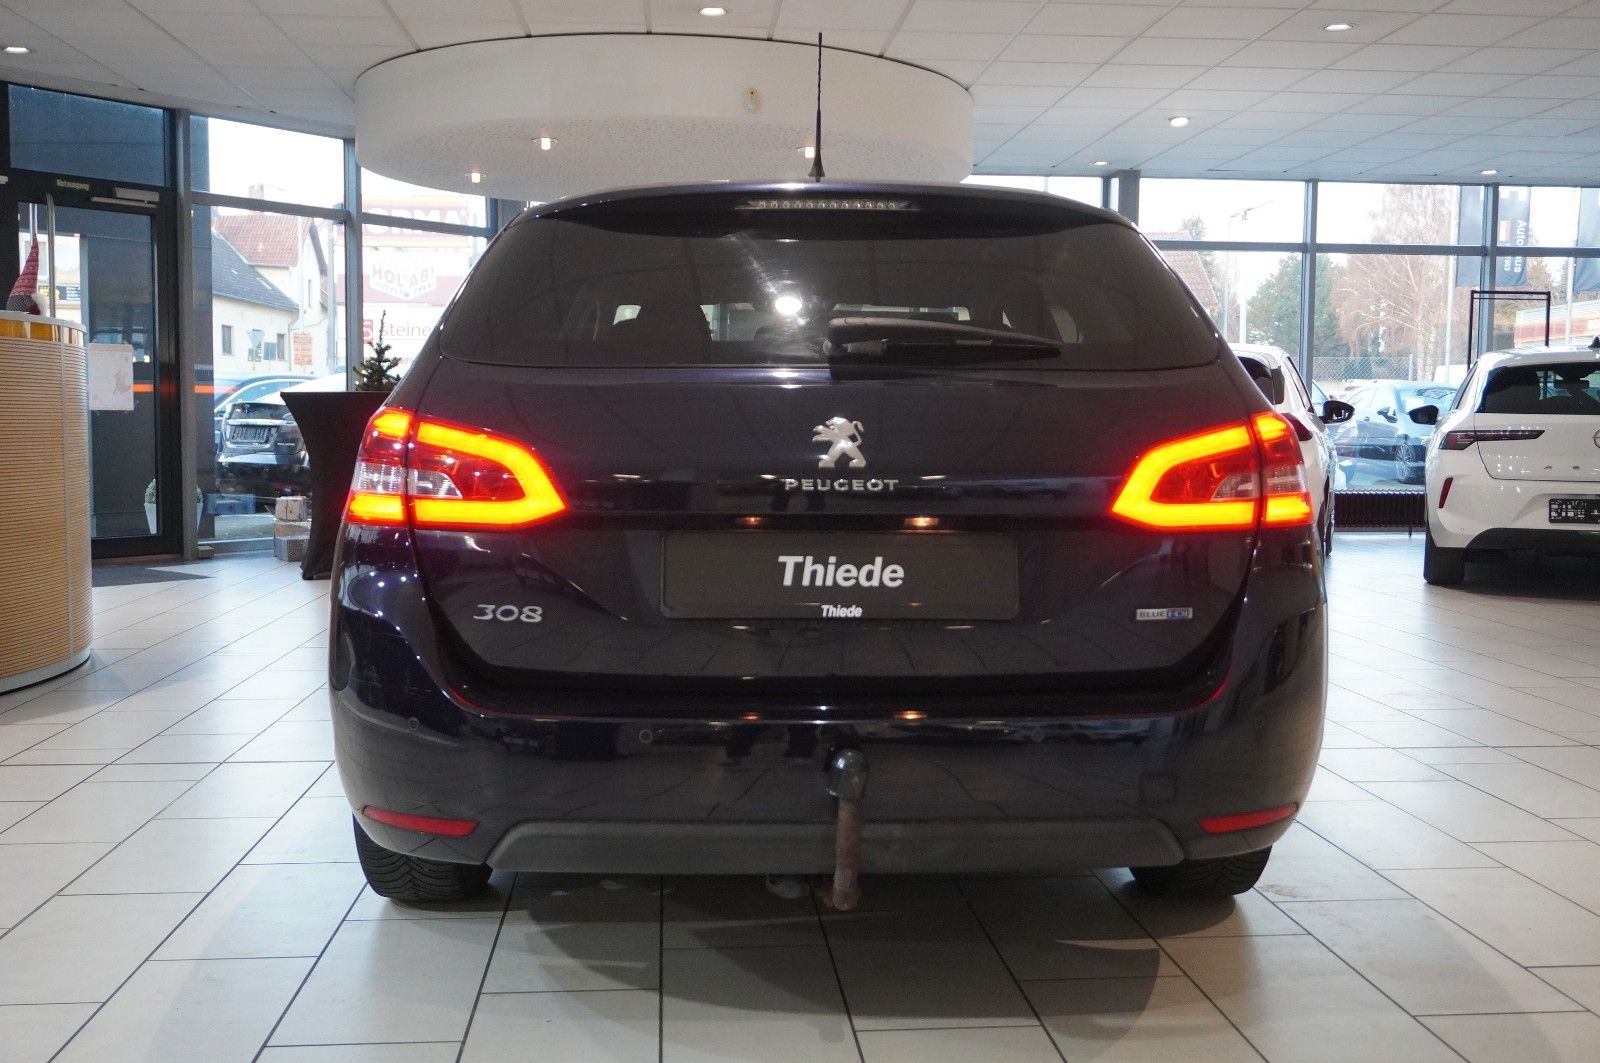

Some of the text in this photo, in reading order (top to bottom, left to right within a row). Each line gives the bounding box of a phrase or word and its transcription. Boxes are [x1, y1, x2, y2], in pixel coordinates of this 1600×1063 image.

[365, 207, 467, 237] ORMA
[781, 478, 899, 491] PEUGEOT
[778, 555, 905, 588] Thiede
[472, 604, 543, 623] 308
[821, 604, 863, 618] Thiede
